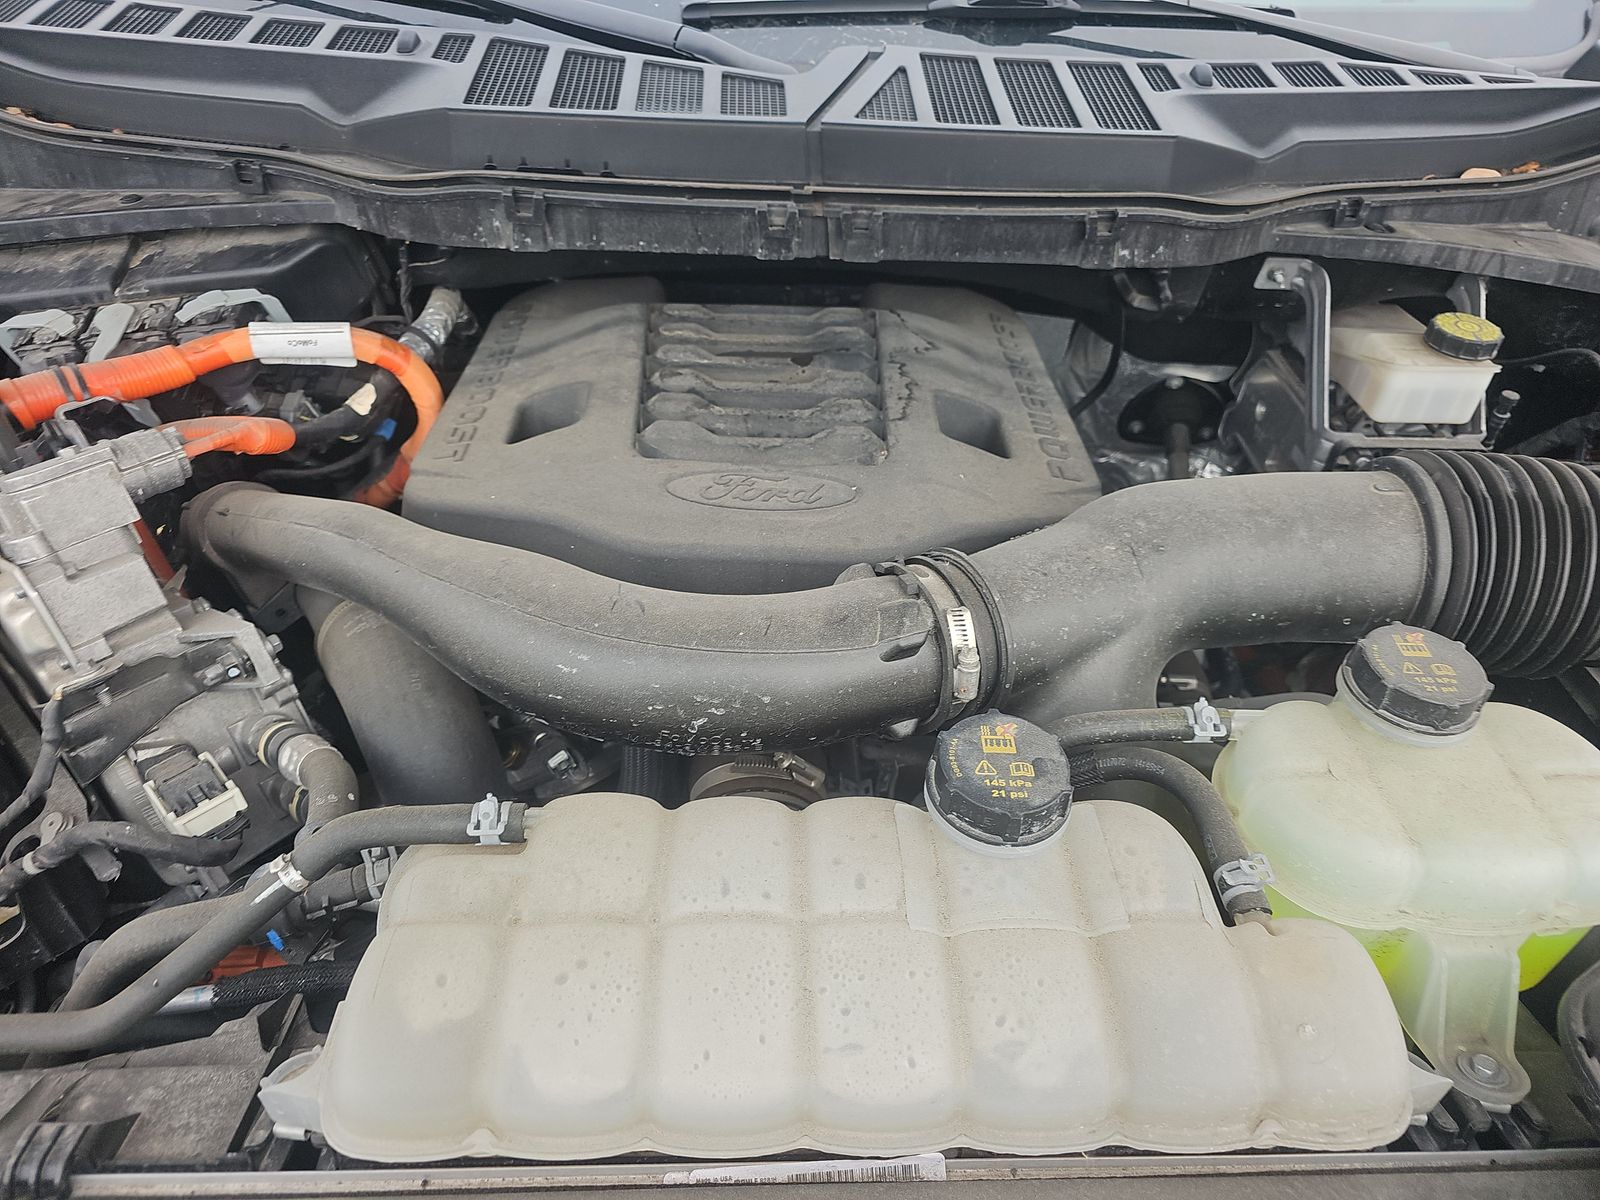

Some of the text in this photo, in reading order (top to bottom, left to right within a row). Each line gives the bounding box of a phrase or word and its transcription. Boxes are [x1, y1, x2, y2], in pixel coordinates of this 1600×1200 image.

[287, 339, 319, 347] FoMoCo
[700, 473, 826, 505] Ford
[984, 779, 1033, 788] 145 kPa
[991, 789, 1029, 799] 21 psi
